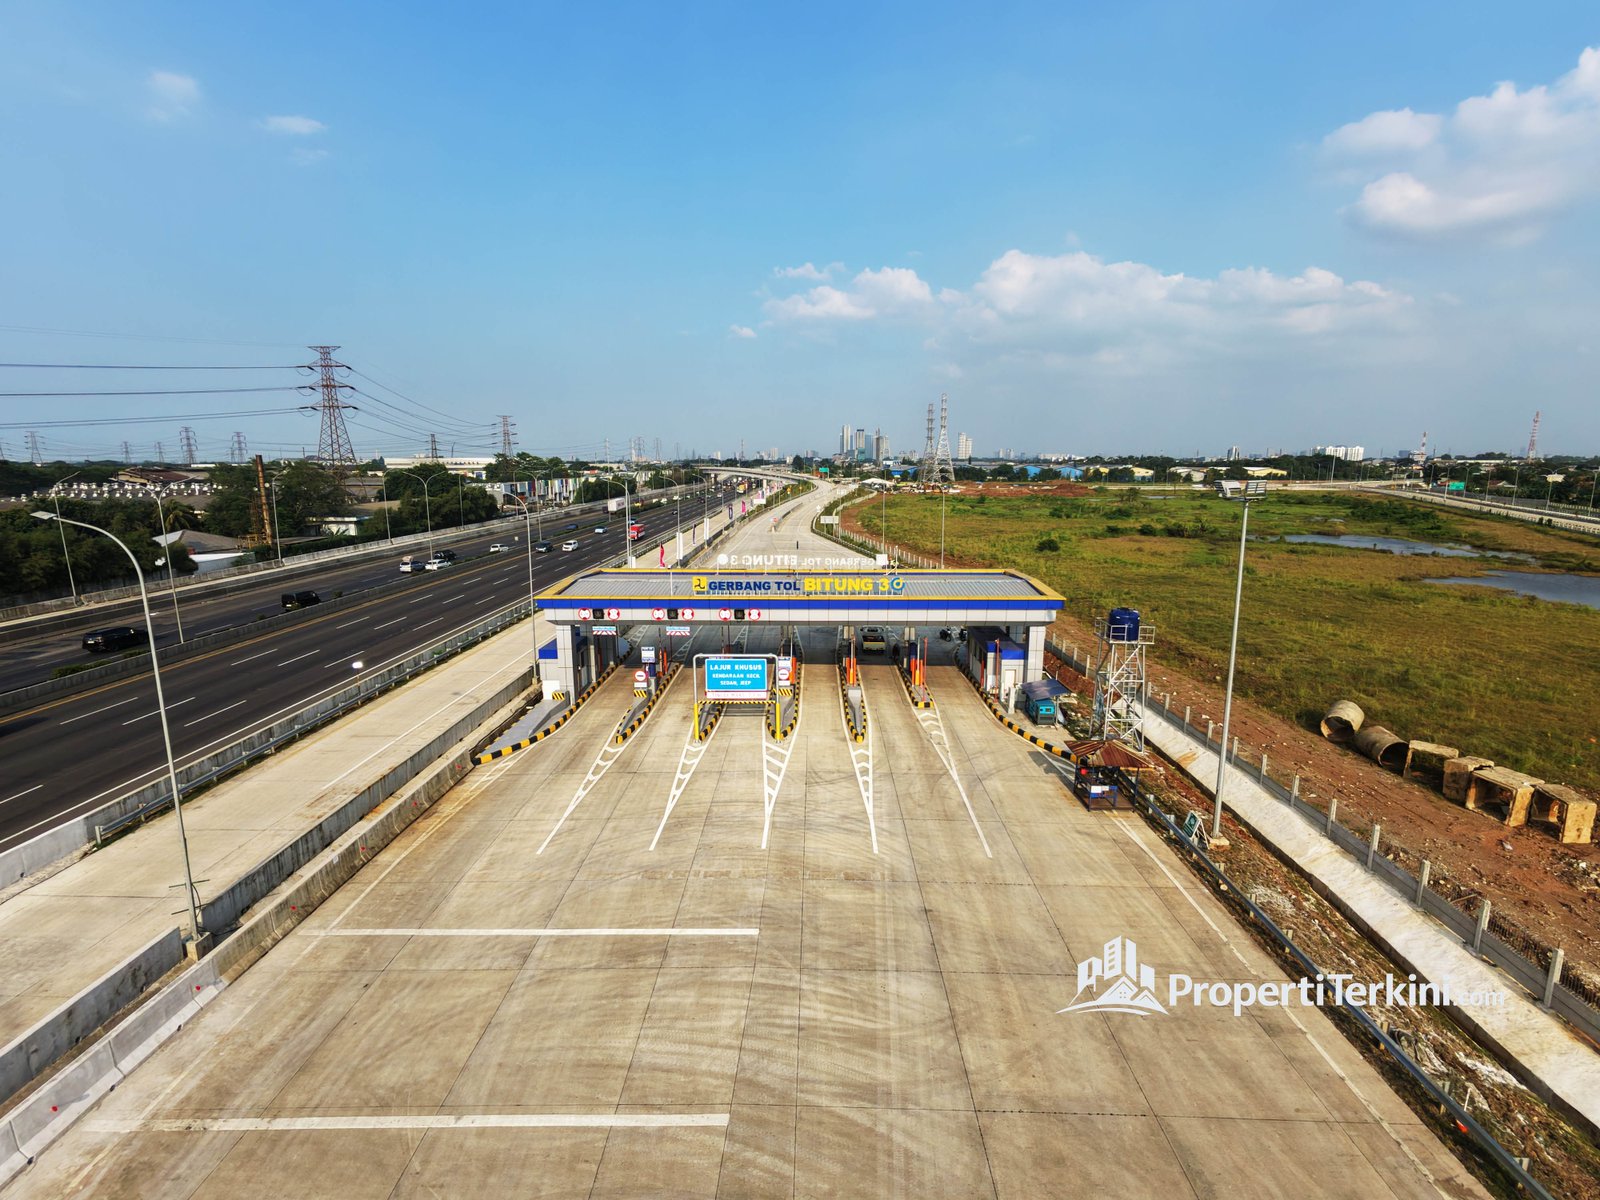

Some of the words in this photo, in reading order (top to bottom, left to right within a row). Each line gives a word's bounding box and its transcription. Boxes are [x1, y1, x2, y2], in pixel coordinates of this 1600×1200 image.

[708, 580, 771, 591] GERBANG
[775, 580, 801, 591] TOL
[804, 576, 874, 591] BITUNG
[879, 577, 890, 591] 3
